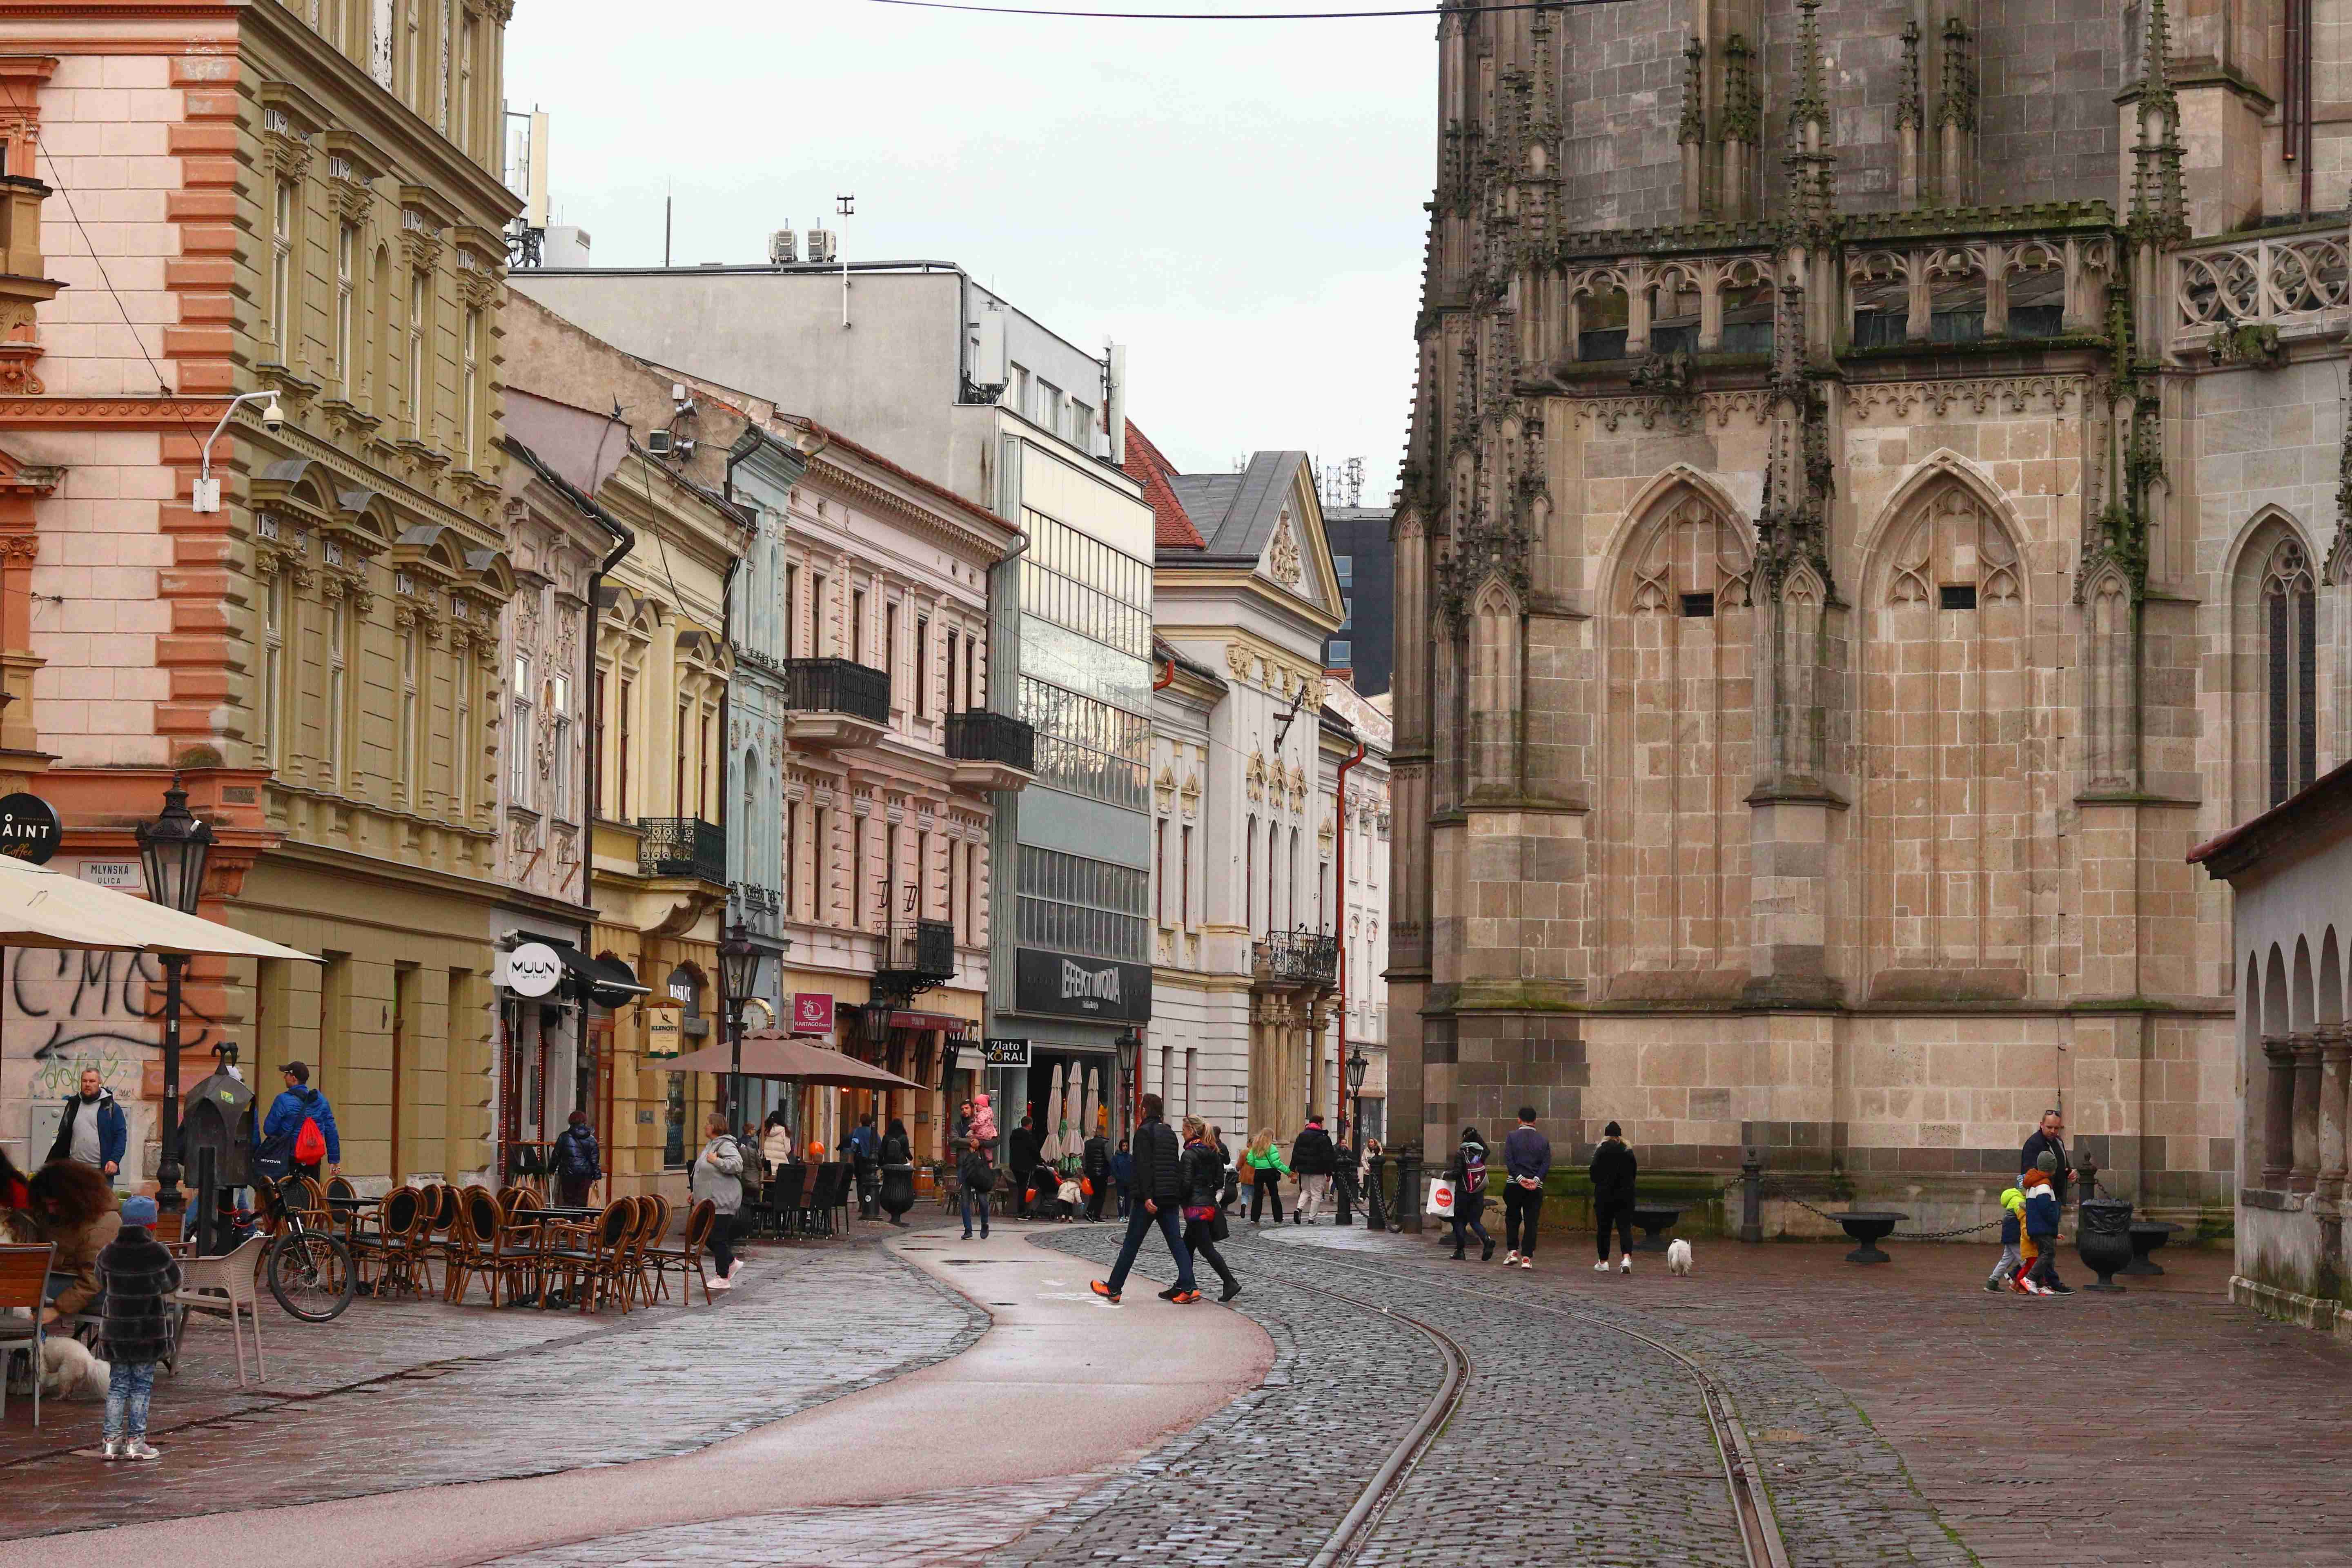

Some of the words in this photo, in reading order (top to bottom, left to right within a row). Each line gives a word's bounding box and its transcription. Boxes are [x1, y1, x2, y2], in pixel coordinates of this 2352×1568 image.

[2, 843, 33, 858] Coffee
[91, 864, 129, 875] MLYNSKÁ
[512, 961, 555, 974] MUUN
[1062, 959, 1092, 998] EFEKT
[1092, 967, 1120, 1004] MODA
[991, 1041, 1020, 1051] Zlato
[987, 1050, 1025, 1061] KORAL
